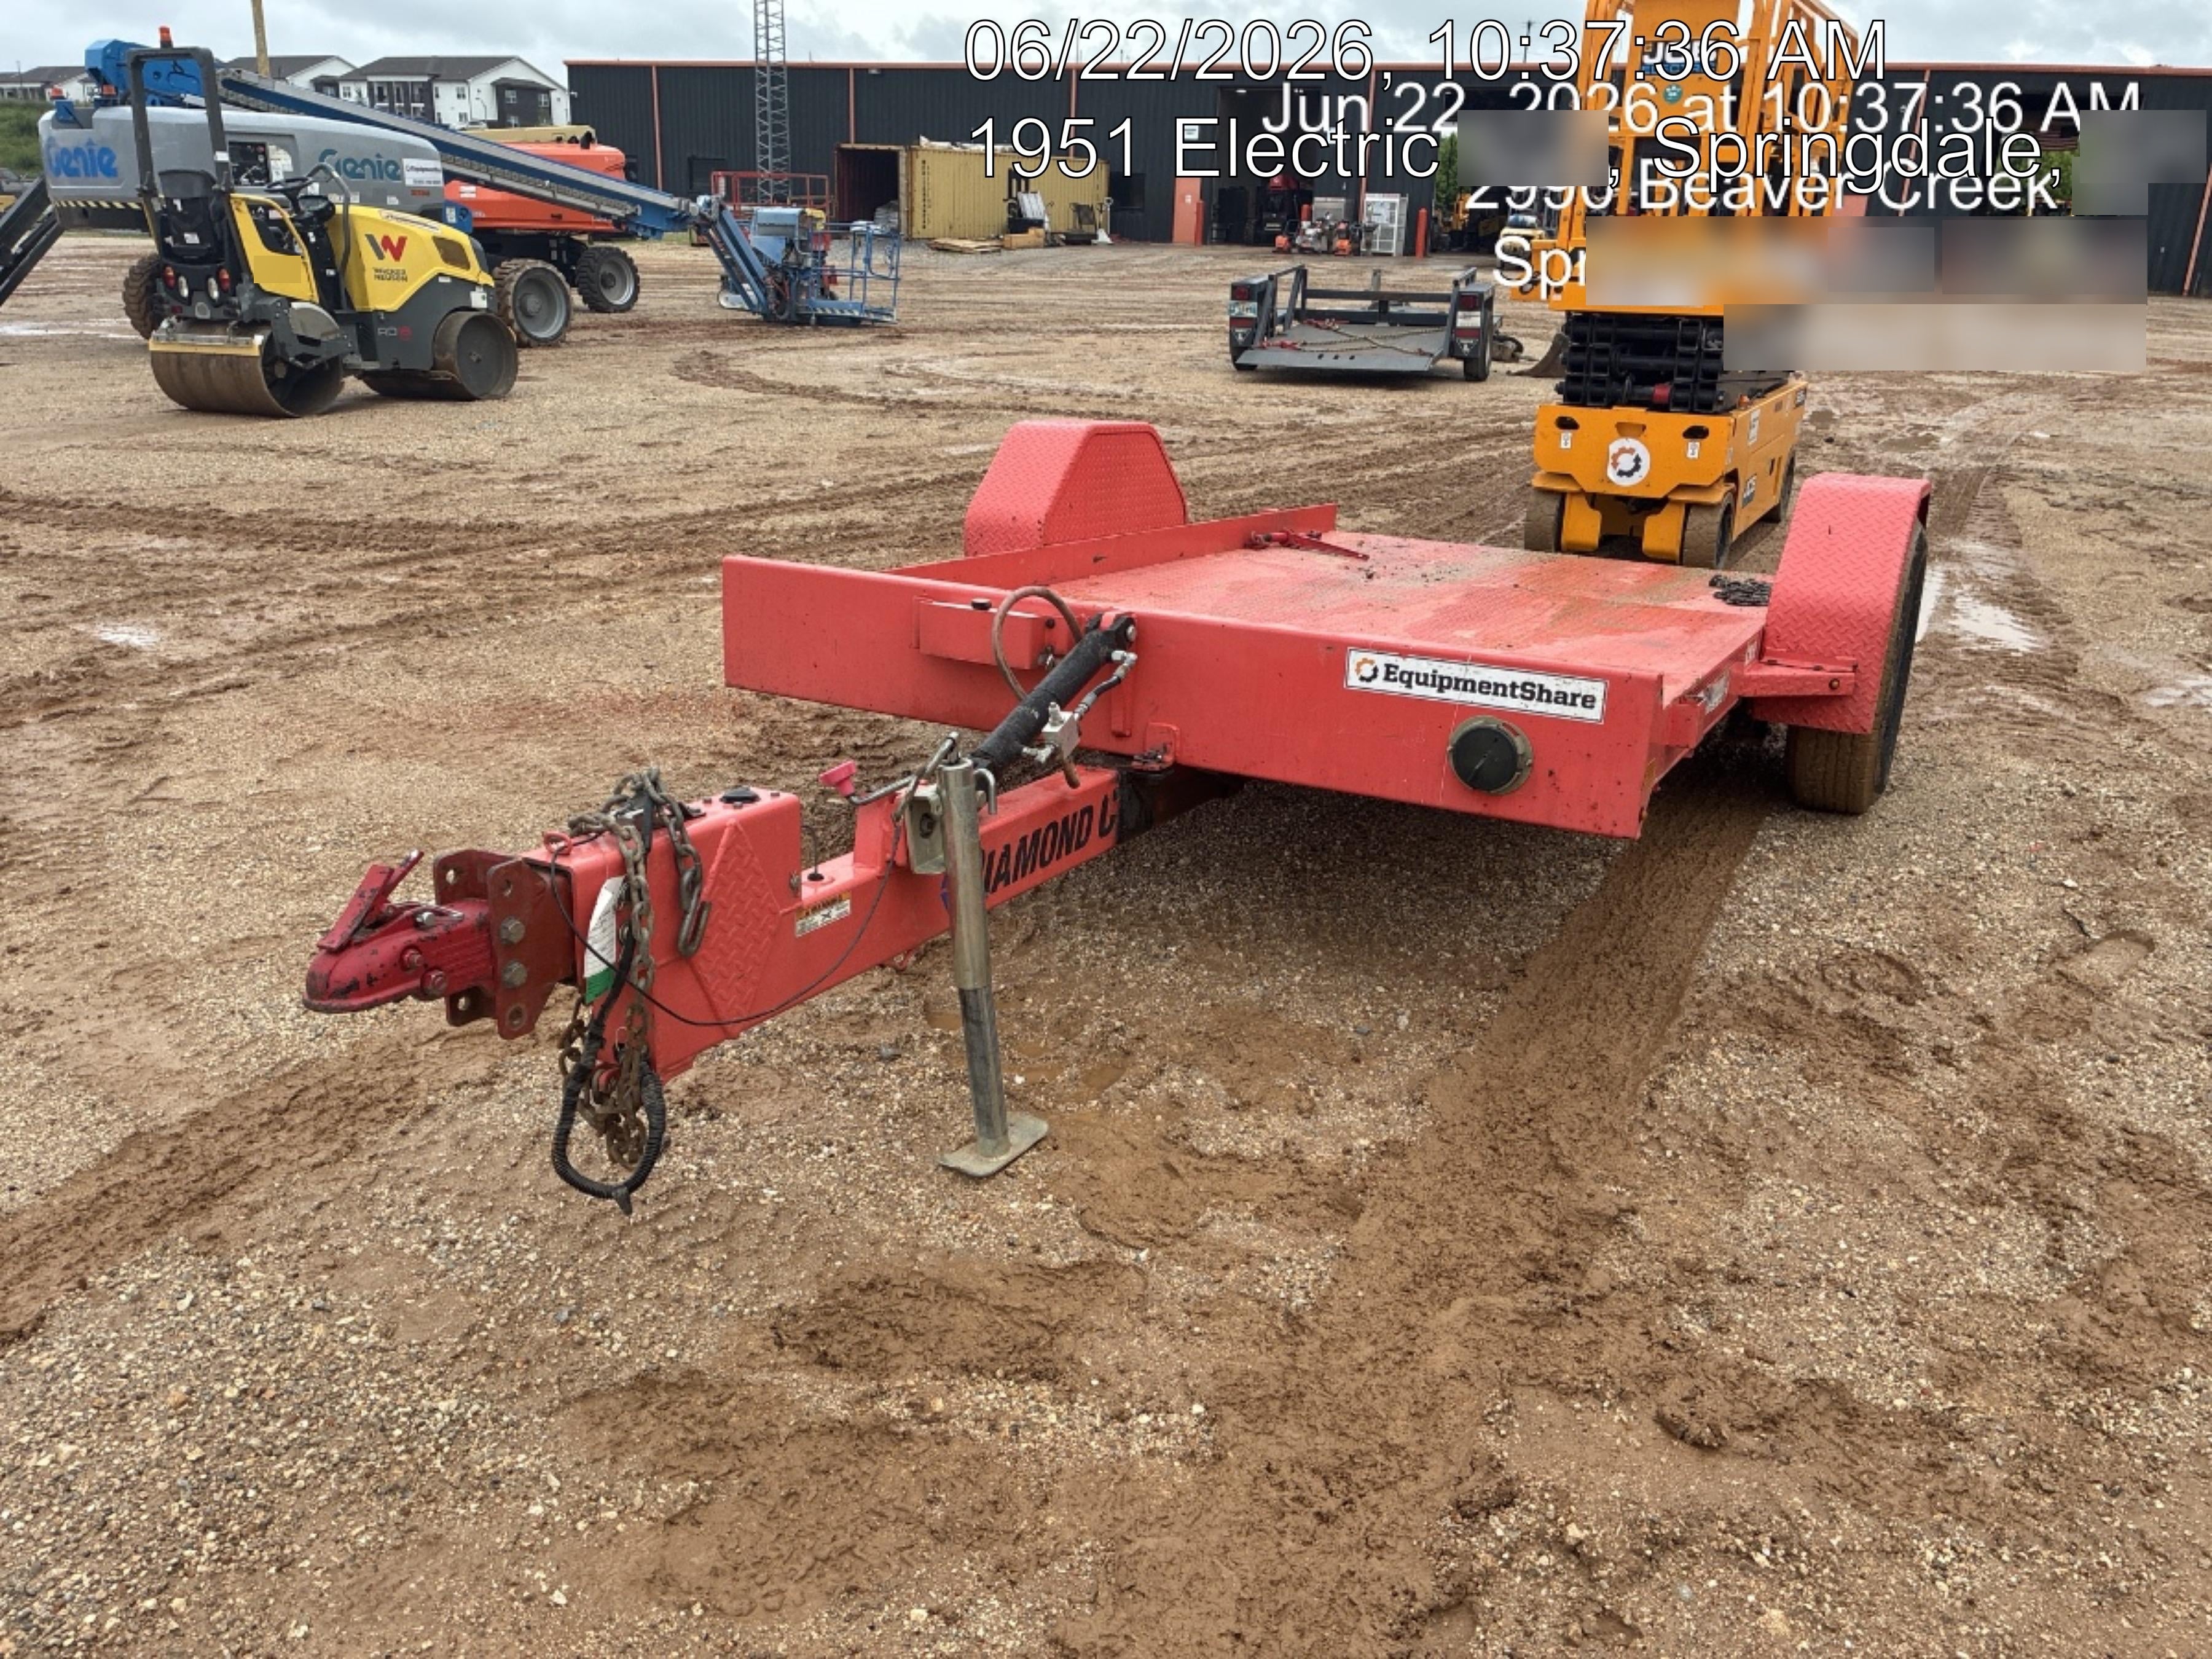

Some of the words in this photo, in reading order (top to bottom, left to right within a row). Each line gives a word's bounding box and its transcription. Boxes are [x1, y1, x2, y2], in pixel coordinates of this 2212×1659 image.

[47, 136, 119, 178] Genie
[319, 149, 402, 181] Genie
[1383, 663, 1597, 710] EquipmentShare
[982, 804, 1094, 895] IAMOND
